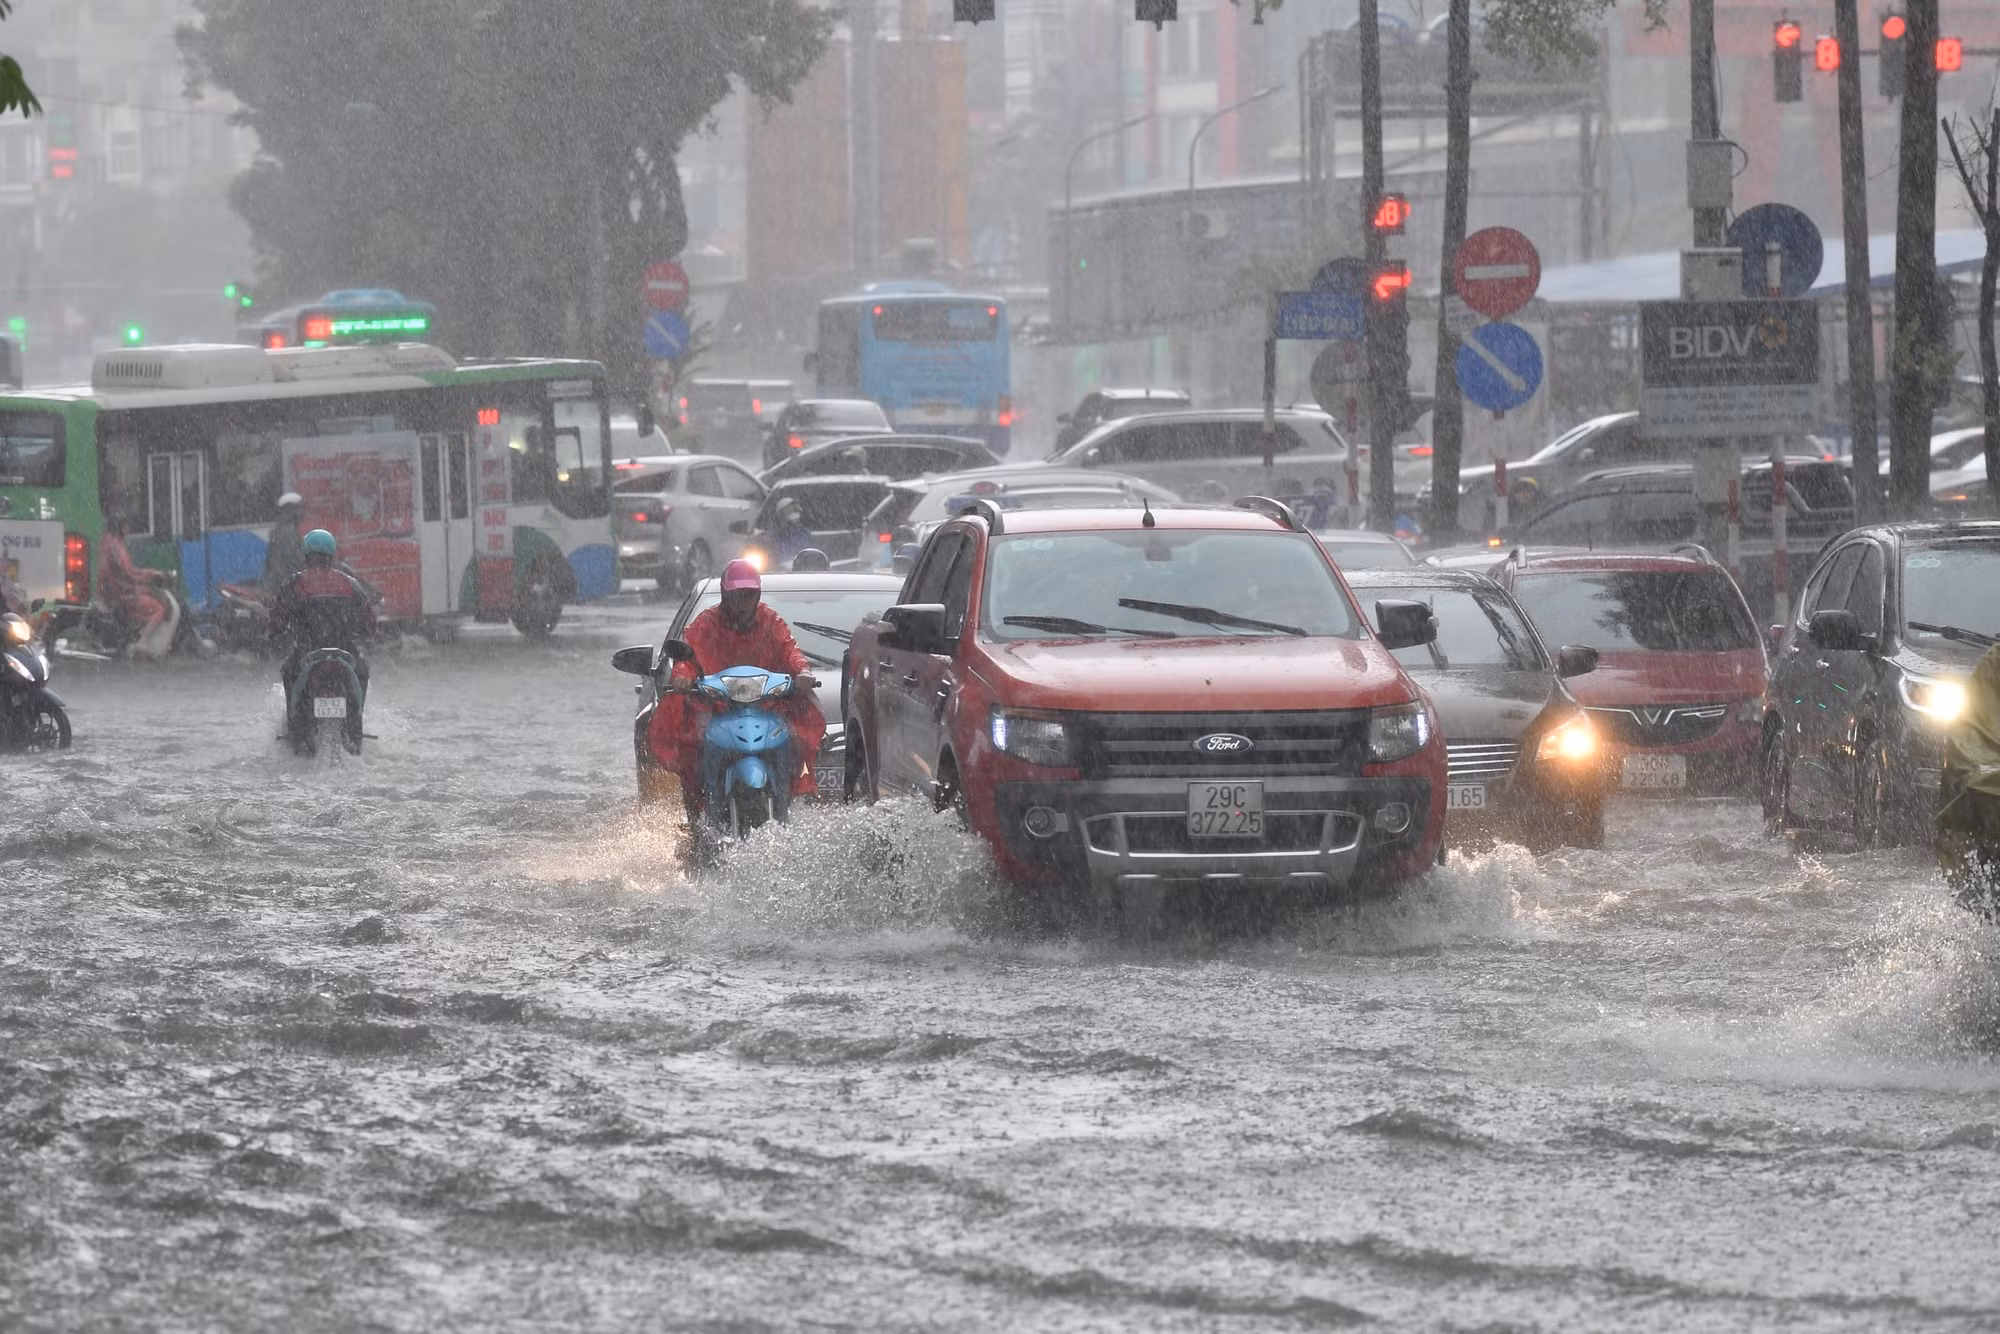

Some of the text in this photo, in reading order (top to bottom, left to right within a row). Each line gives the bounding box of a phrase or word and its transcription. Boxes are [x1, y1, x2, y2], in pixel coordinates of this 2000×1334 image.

[1668, 325, 1756, 359] BIDV
[1207, 736, 1241, 751] Ford
[1206, 785, 1246, 809] 29C
[1191, 811, 1261, 834] 372.25
